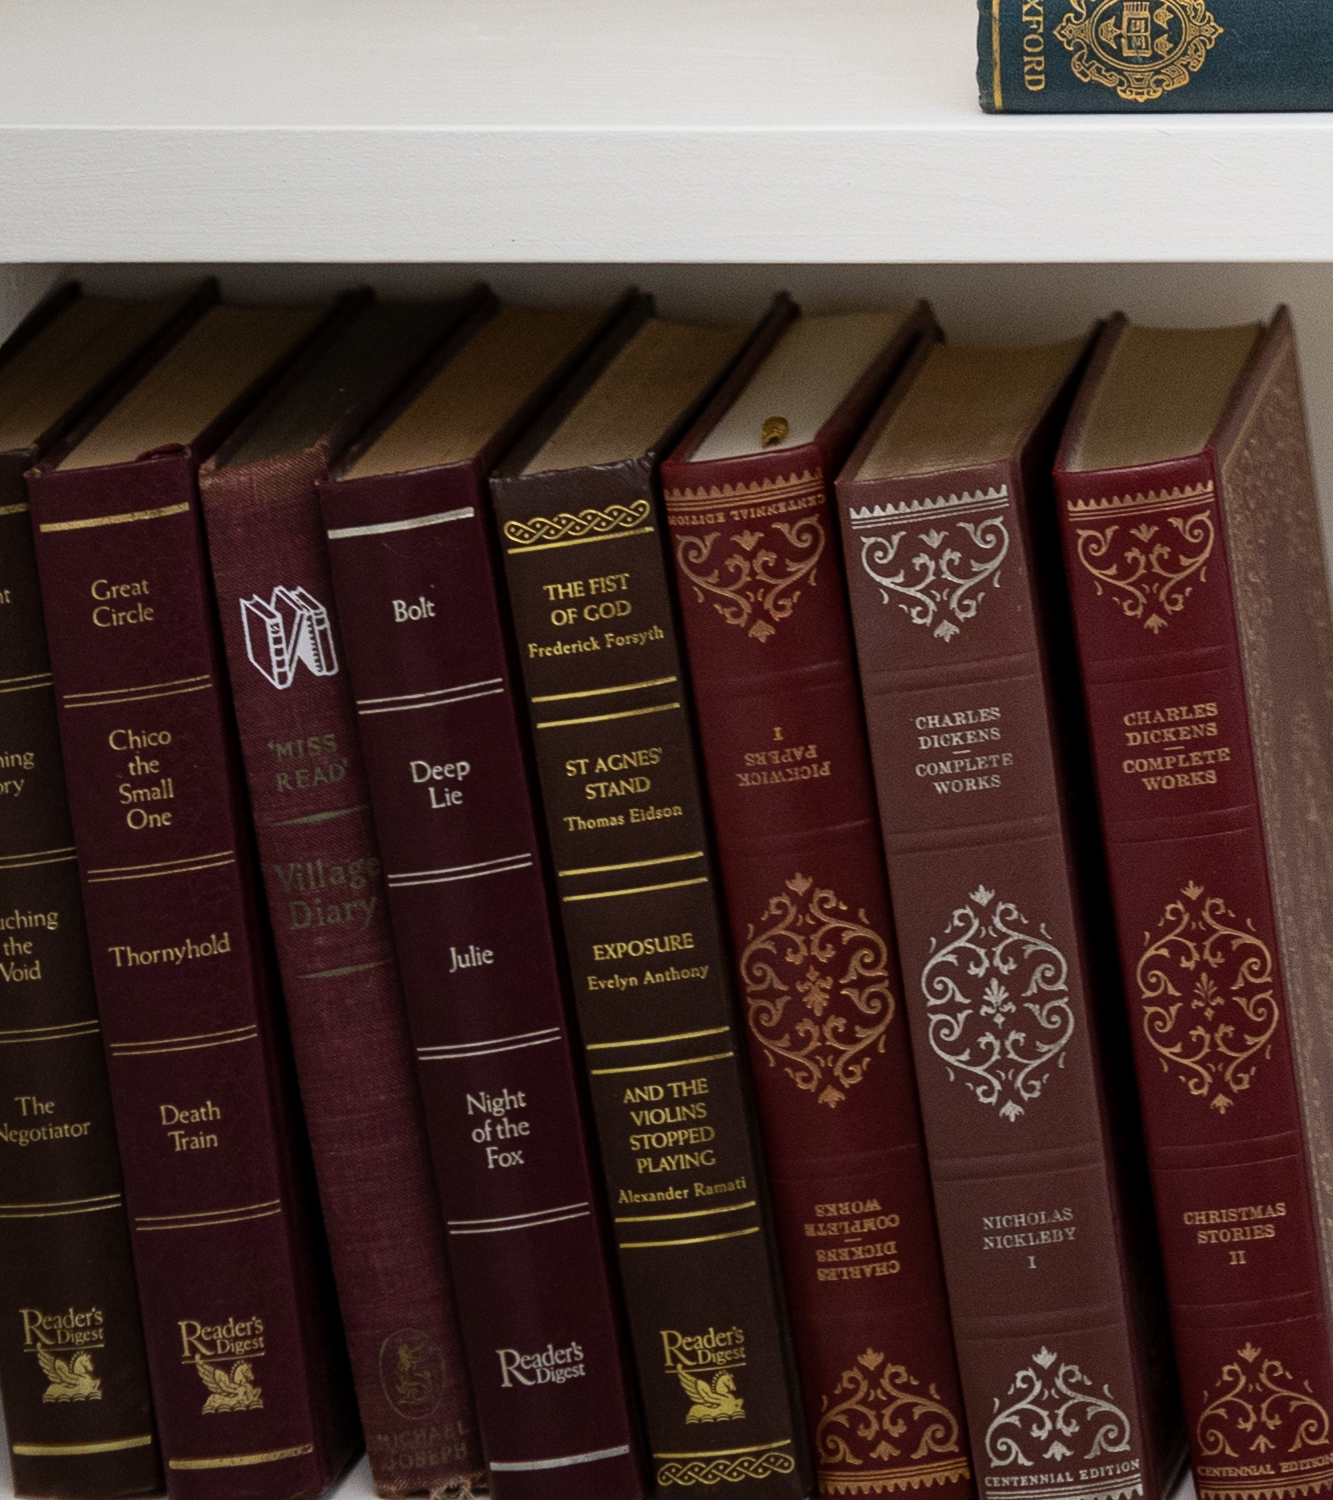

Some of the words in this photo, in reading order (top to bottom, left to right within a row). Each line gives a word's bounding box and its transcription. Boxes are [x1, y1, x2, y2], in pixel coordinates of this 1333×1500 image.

[551, 608, 579, 627] OF
[583, 600, 633, 621] GOD
[108, 729, 172, 752] Chico
[128, 755, 160, 776] the
[118, 779, 175, 804] Small
[585, 777, 652, 800] STAND
[109, 933, 232, 967] Thornyhold
[592, 933, 695, 961] EXPOSURE
[623, 1085, 664, 1104] AND
[667, 1078, 709, 1096] THE
[630, 1103, 707, 1127] VIOLINS
[629, 1126, 716, 1151] STOPPED
[637, 1150, 717, 1174] PLAYING
